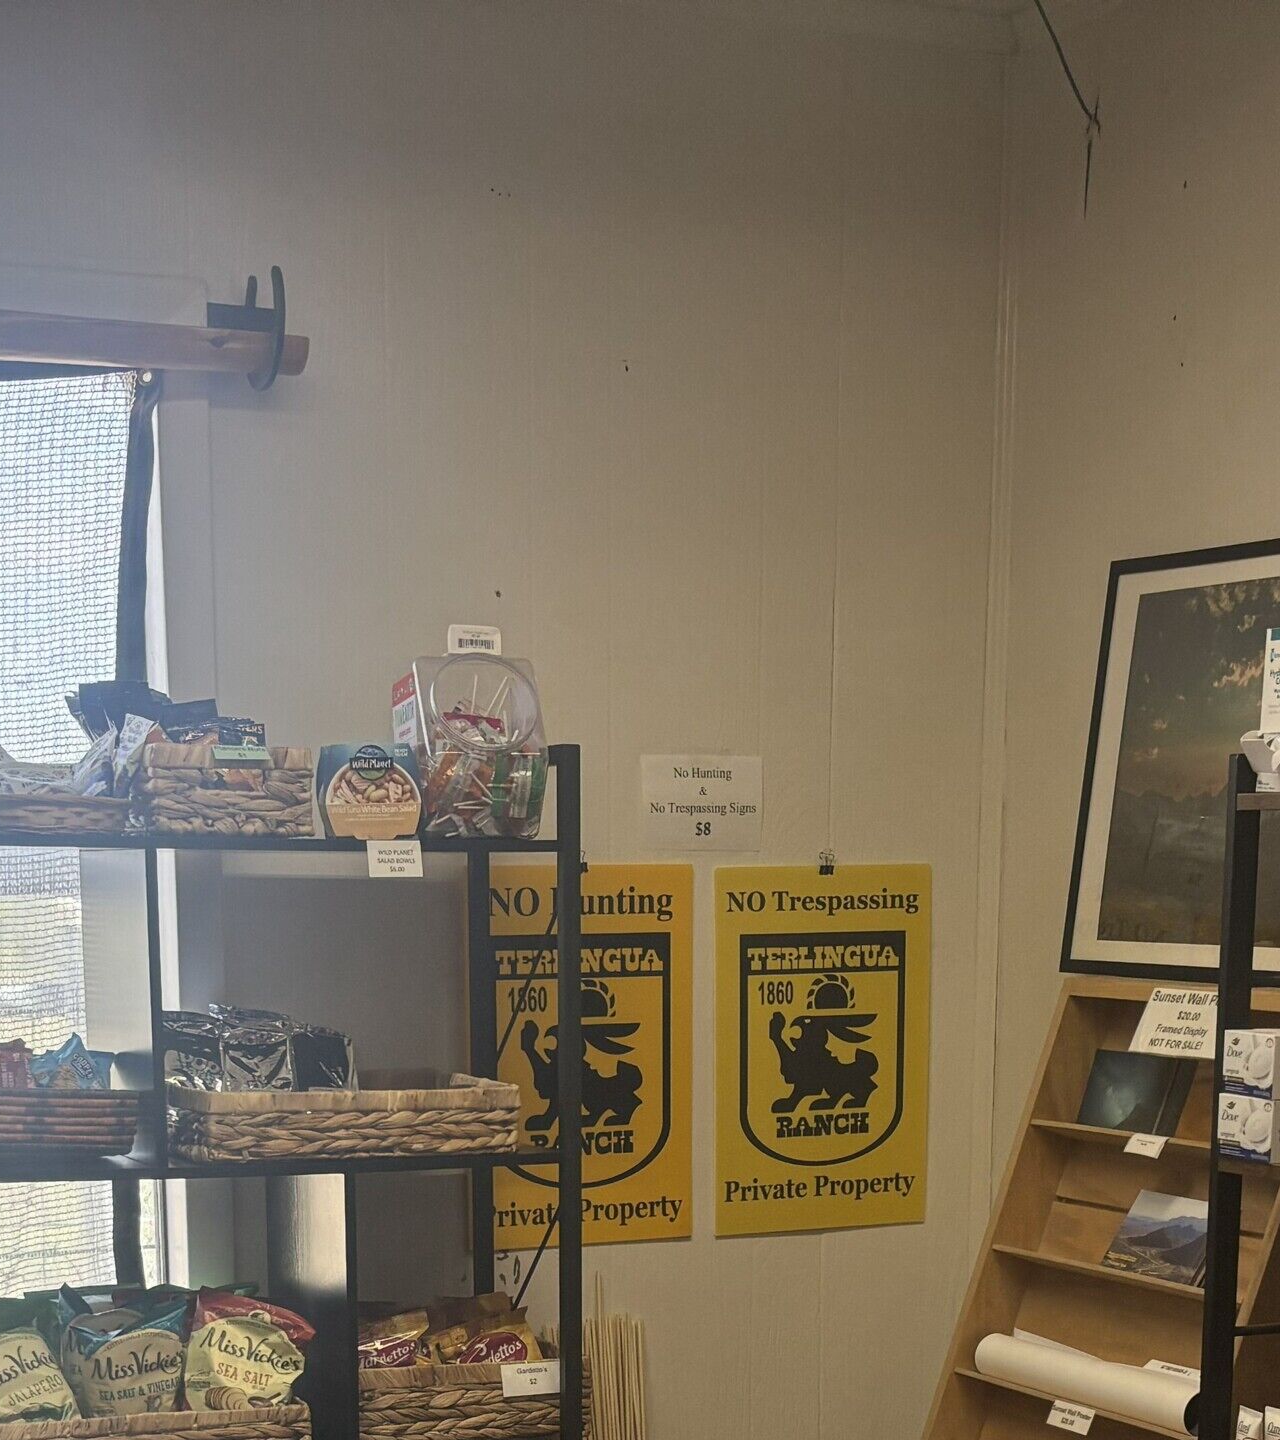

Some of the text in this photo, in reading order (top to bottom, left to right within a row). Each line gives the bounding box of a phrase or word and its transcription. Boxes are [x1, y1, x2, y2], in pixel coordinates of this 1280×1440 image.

[673, 766, 732, 781] No Hunting
[699, 786, 707, 795] &
[650, 802, 757, 816] No Trespassing Signs
[695, 821, 711, 836] $8
[488, 887, 674, 921] NO unting
[726, 889, 919, 914] NO Trespassing
[747, 945, 899, 972] TERLINGUA
[757, 981, 794, 1006] 1860
[1153, 990, 1187, 1005] Sunset
[1188, 992, 1207, 1006] Wall
[1177, 1011, 1201, 1022] $20.00
[1154, 1023, 1208, 1038] Framed Display
[1148, 1038, 1204, 1050] NOT FOR SALE!
[1226, 1045, 1243, 1058] Dove
[1221, 1108, 1239, 1121] Dove
[776, 1111, 869, 1138] RANCH
[724, 1171, 915, 1203] Private Property
[577, 1195, 683, 1226] Property
[200, 1327, 246, 1358] Miss
[244, 1336, 301, 1375] Vickie's
[91, 1344, 185, 1381] Miss Vickie's
[216, 1363, 273, 1387] SEA SALT
[99, 1389, 115, 1401] SEA
[117, 1386, 136, 1400] SALT
